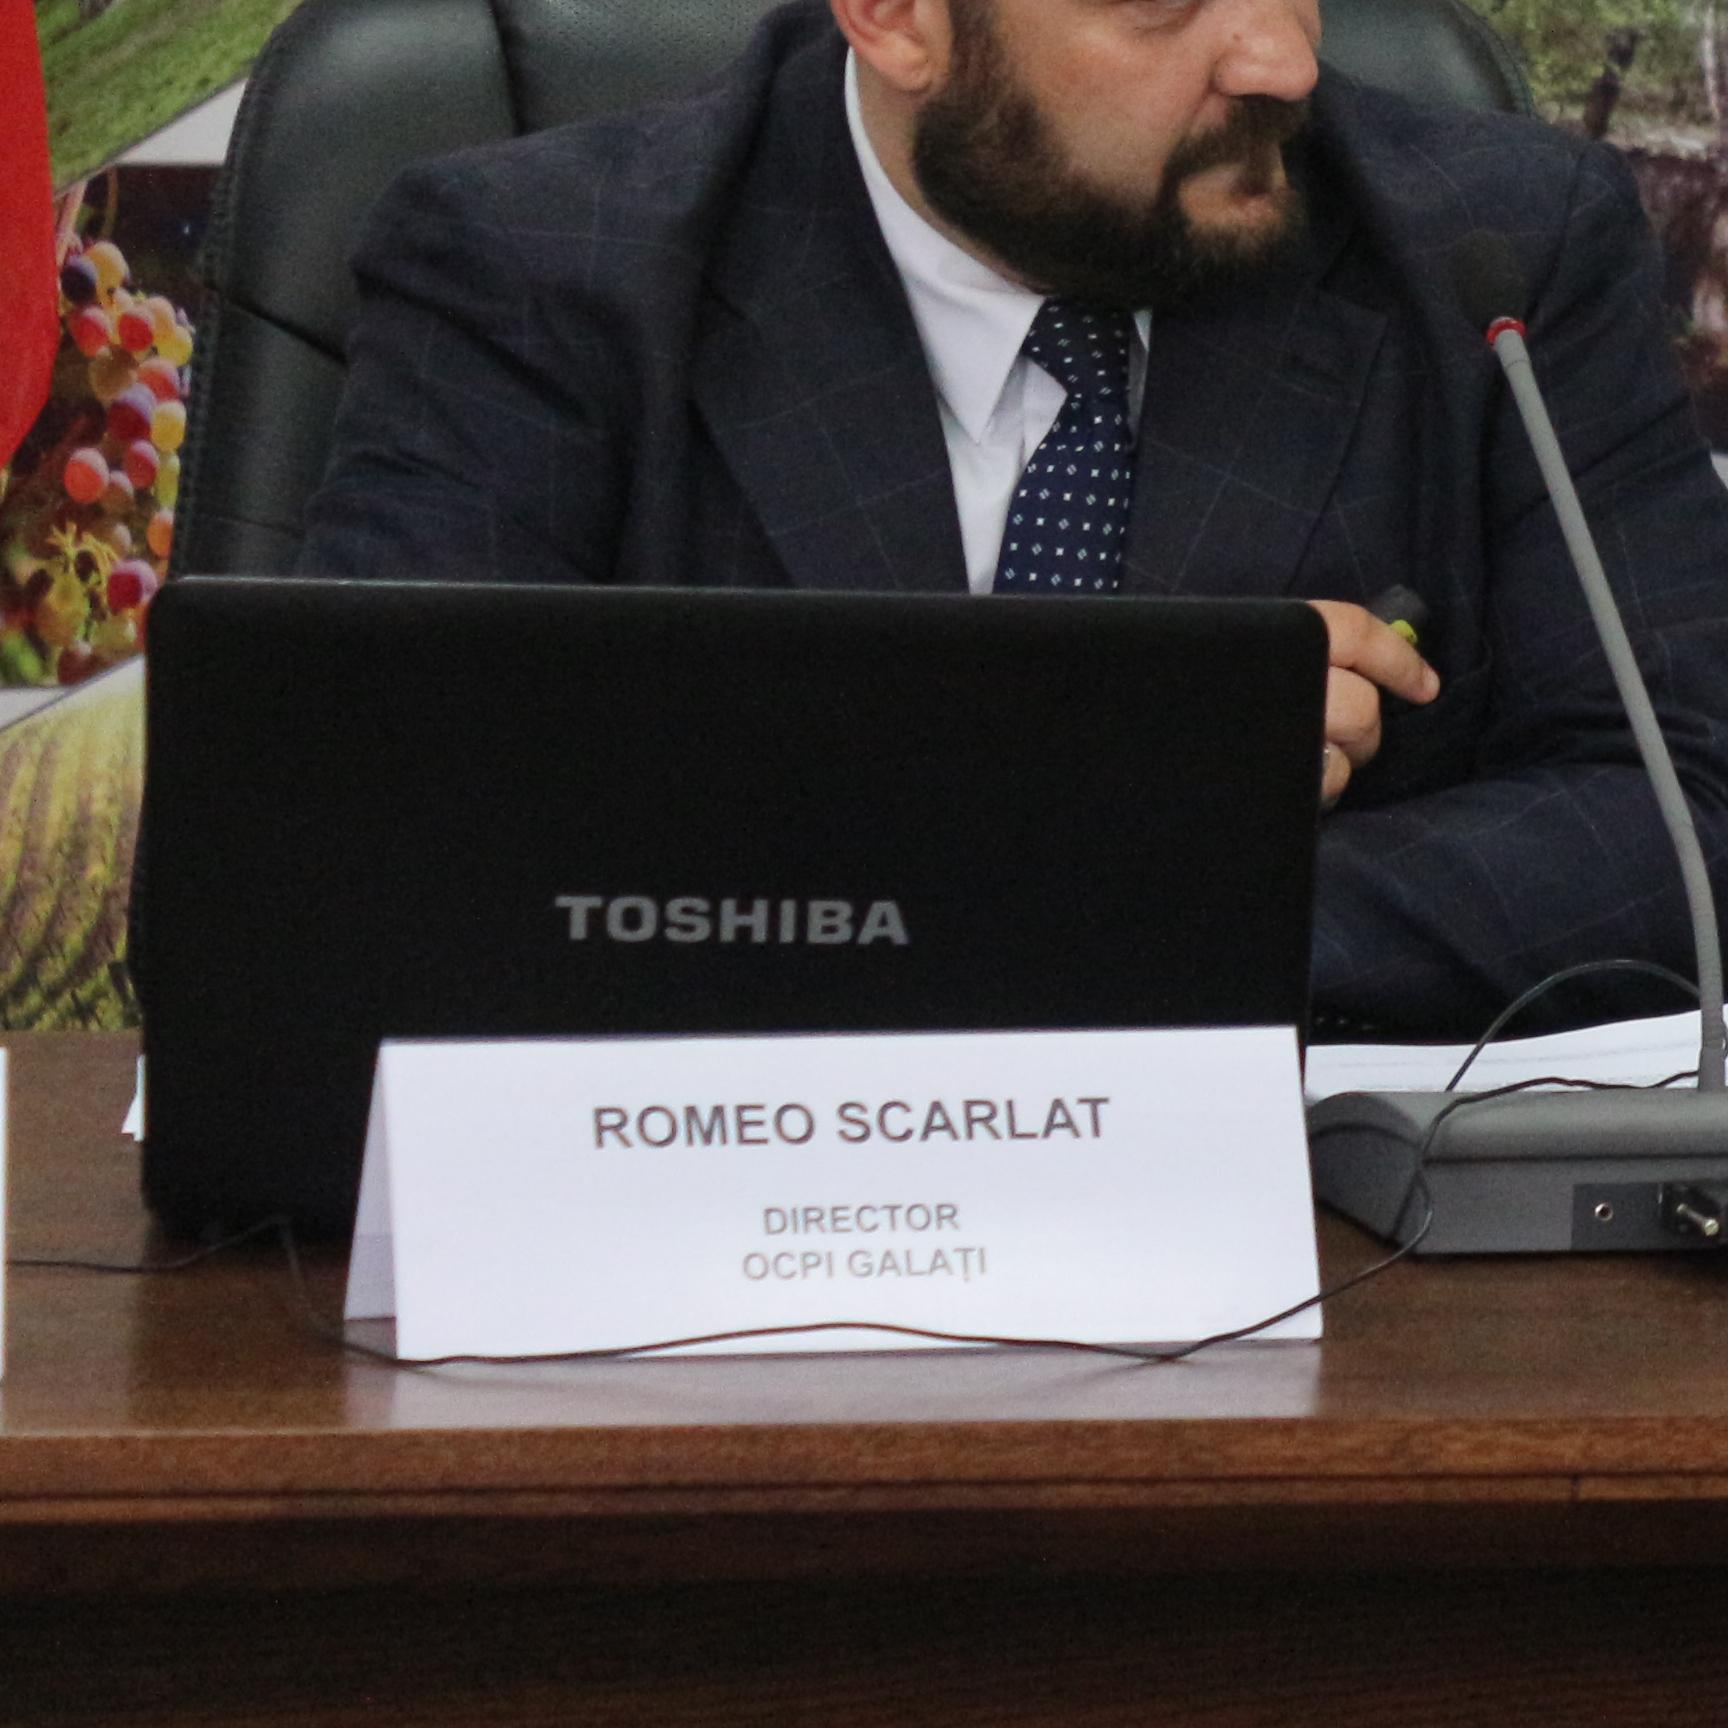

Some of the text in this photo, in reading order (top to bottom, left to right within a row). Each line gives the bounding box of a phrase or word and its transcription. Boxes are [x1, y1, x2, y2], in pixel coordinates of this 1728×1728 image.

[555, 895, 909, 946] TOSHIBA
[593, 1097, 1110, 1149] ROMEO SCARLAT
[763, 1202, 960, 1236] DIRECTOR
[742, 1246, 987, 1283] OCPI GALAȚI
